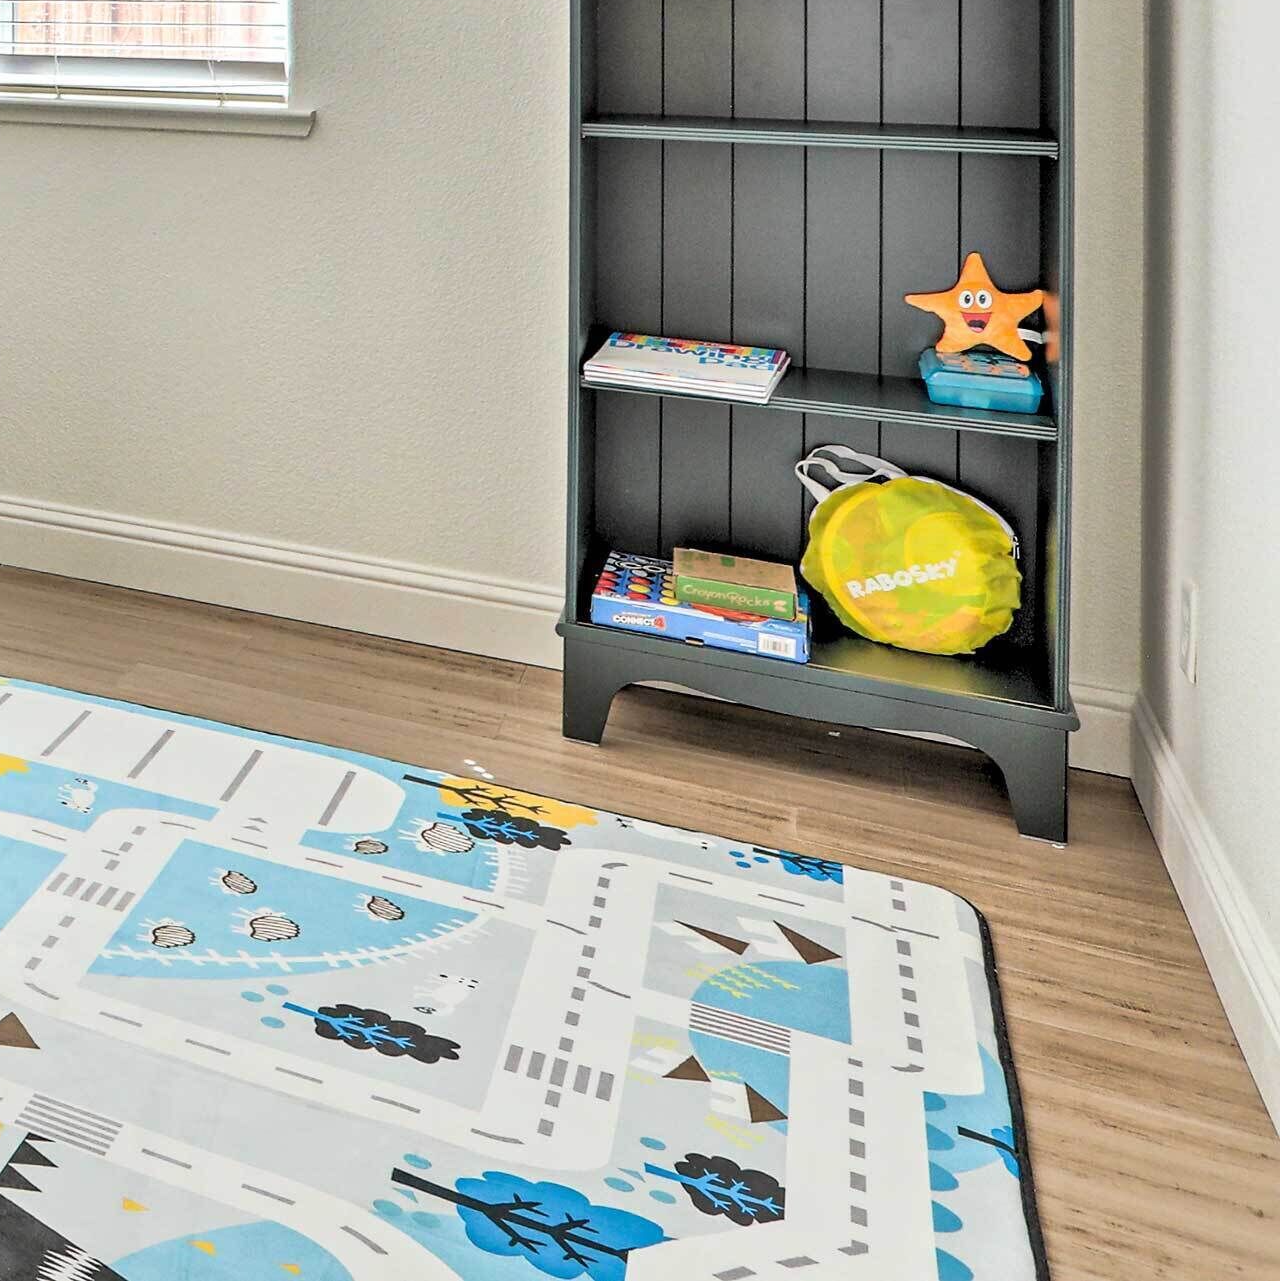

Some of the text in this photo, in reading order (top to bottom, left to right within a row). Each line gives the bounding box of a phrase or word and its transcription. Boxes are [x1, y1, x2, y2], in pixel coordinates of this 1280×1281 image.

[609, 339, 772, 365] Drawing
[699, 356, 776, 371] Pad
[846, 557, 958, 599] RABOSKY
